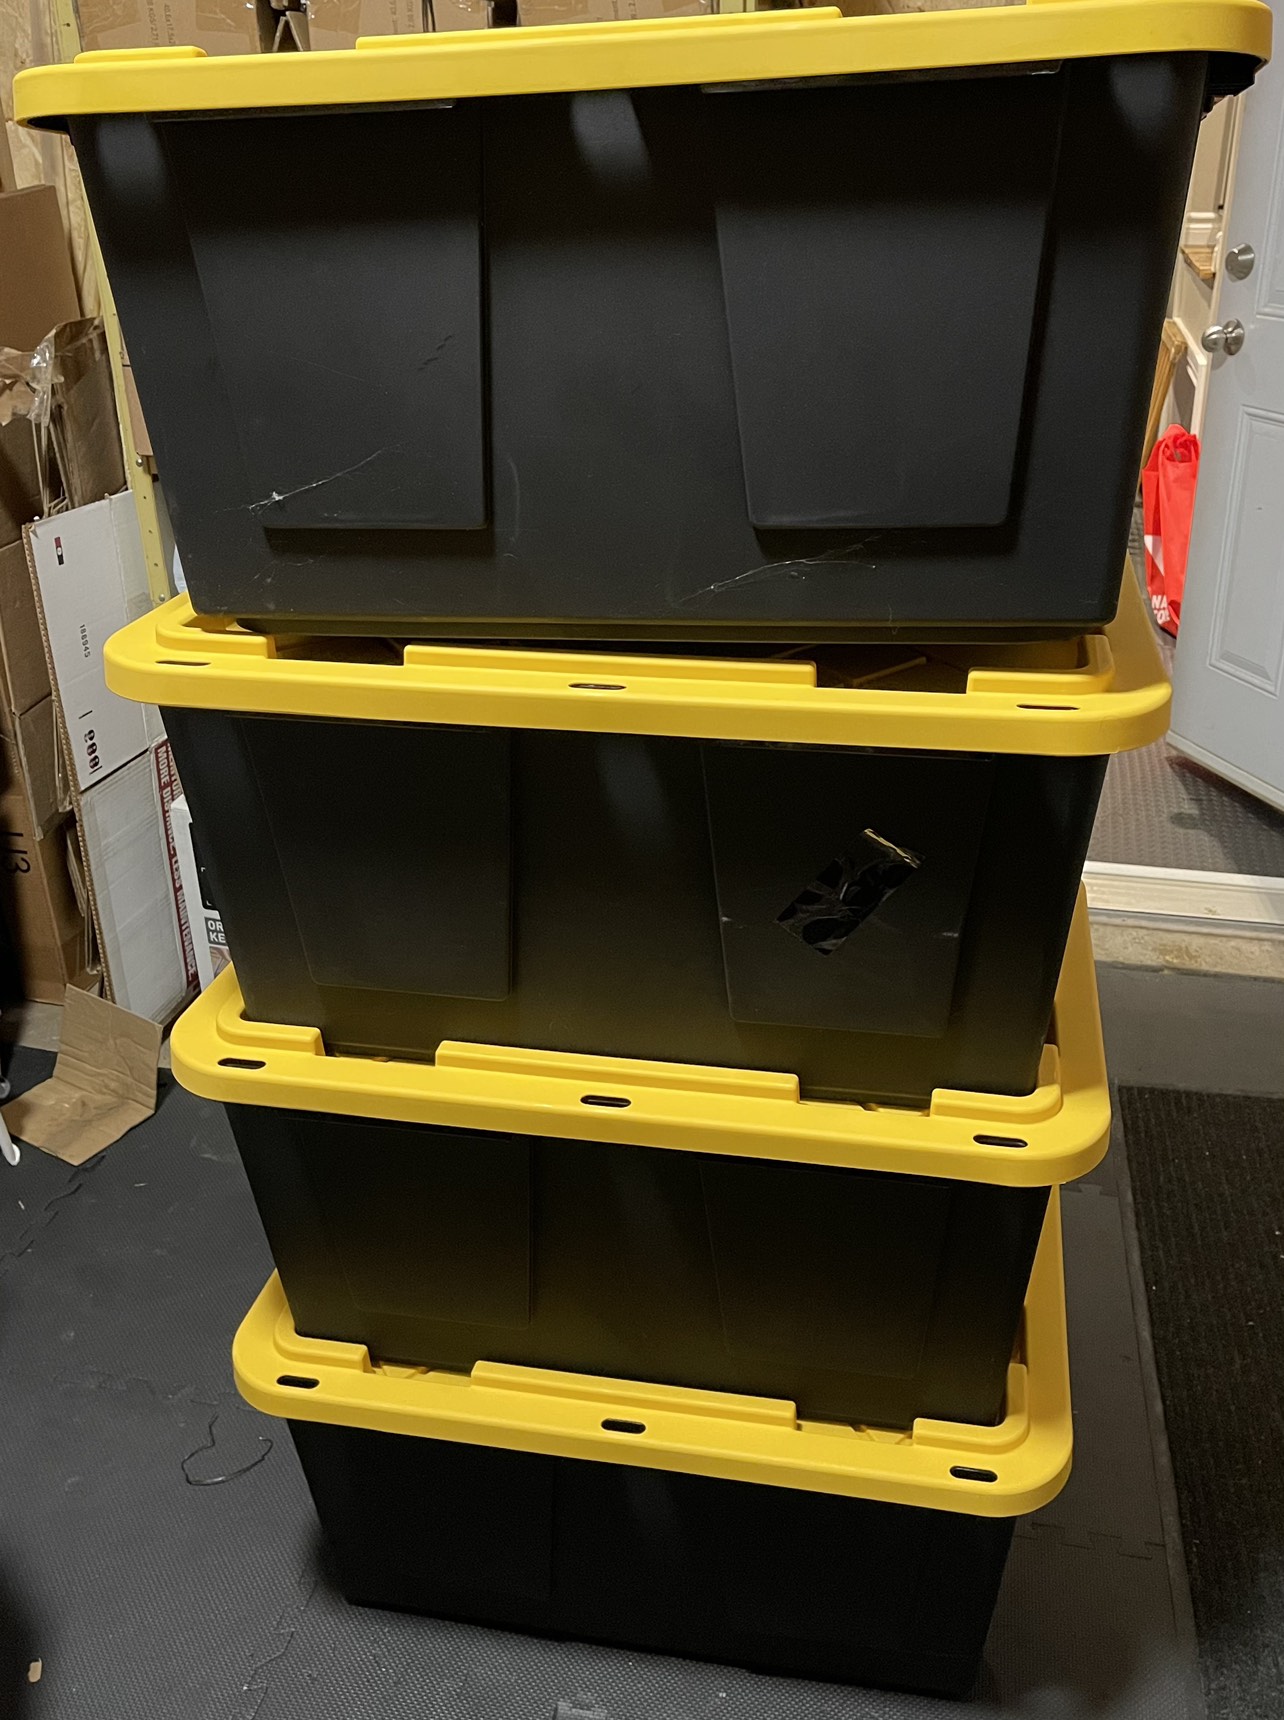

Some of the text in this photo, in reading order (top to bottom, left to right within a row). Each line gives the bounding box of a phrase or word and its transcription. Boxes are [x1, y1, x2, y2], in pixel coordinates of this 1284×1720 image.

[157, 745, 170, 787] MORE
[207, 920, 225, 932] OR
[209, 931, 227, 944] KE
